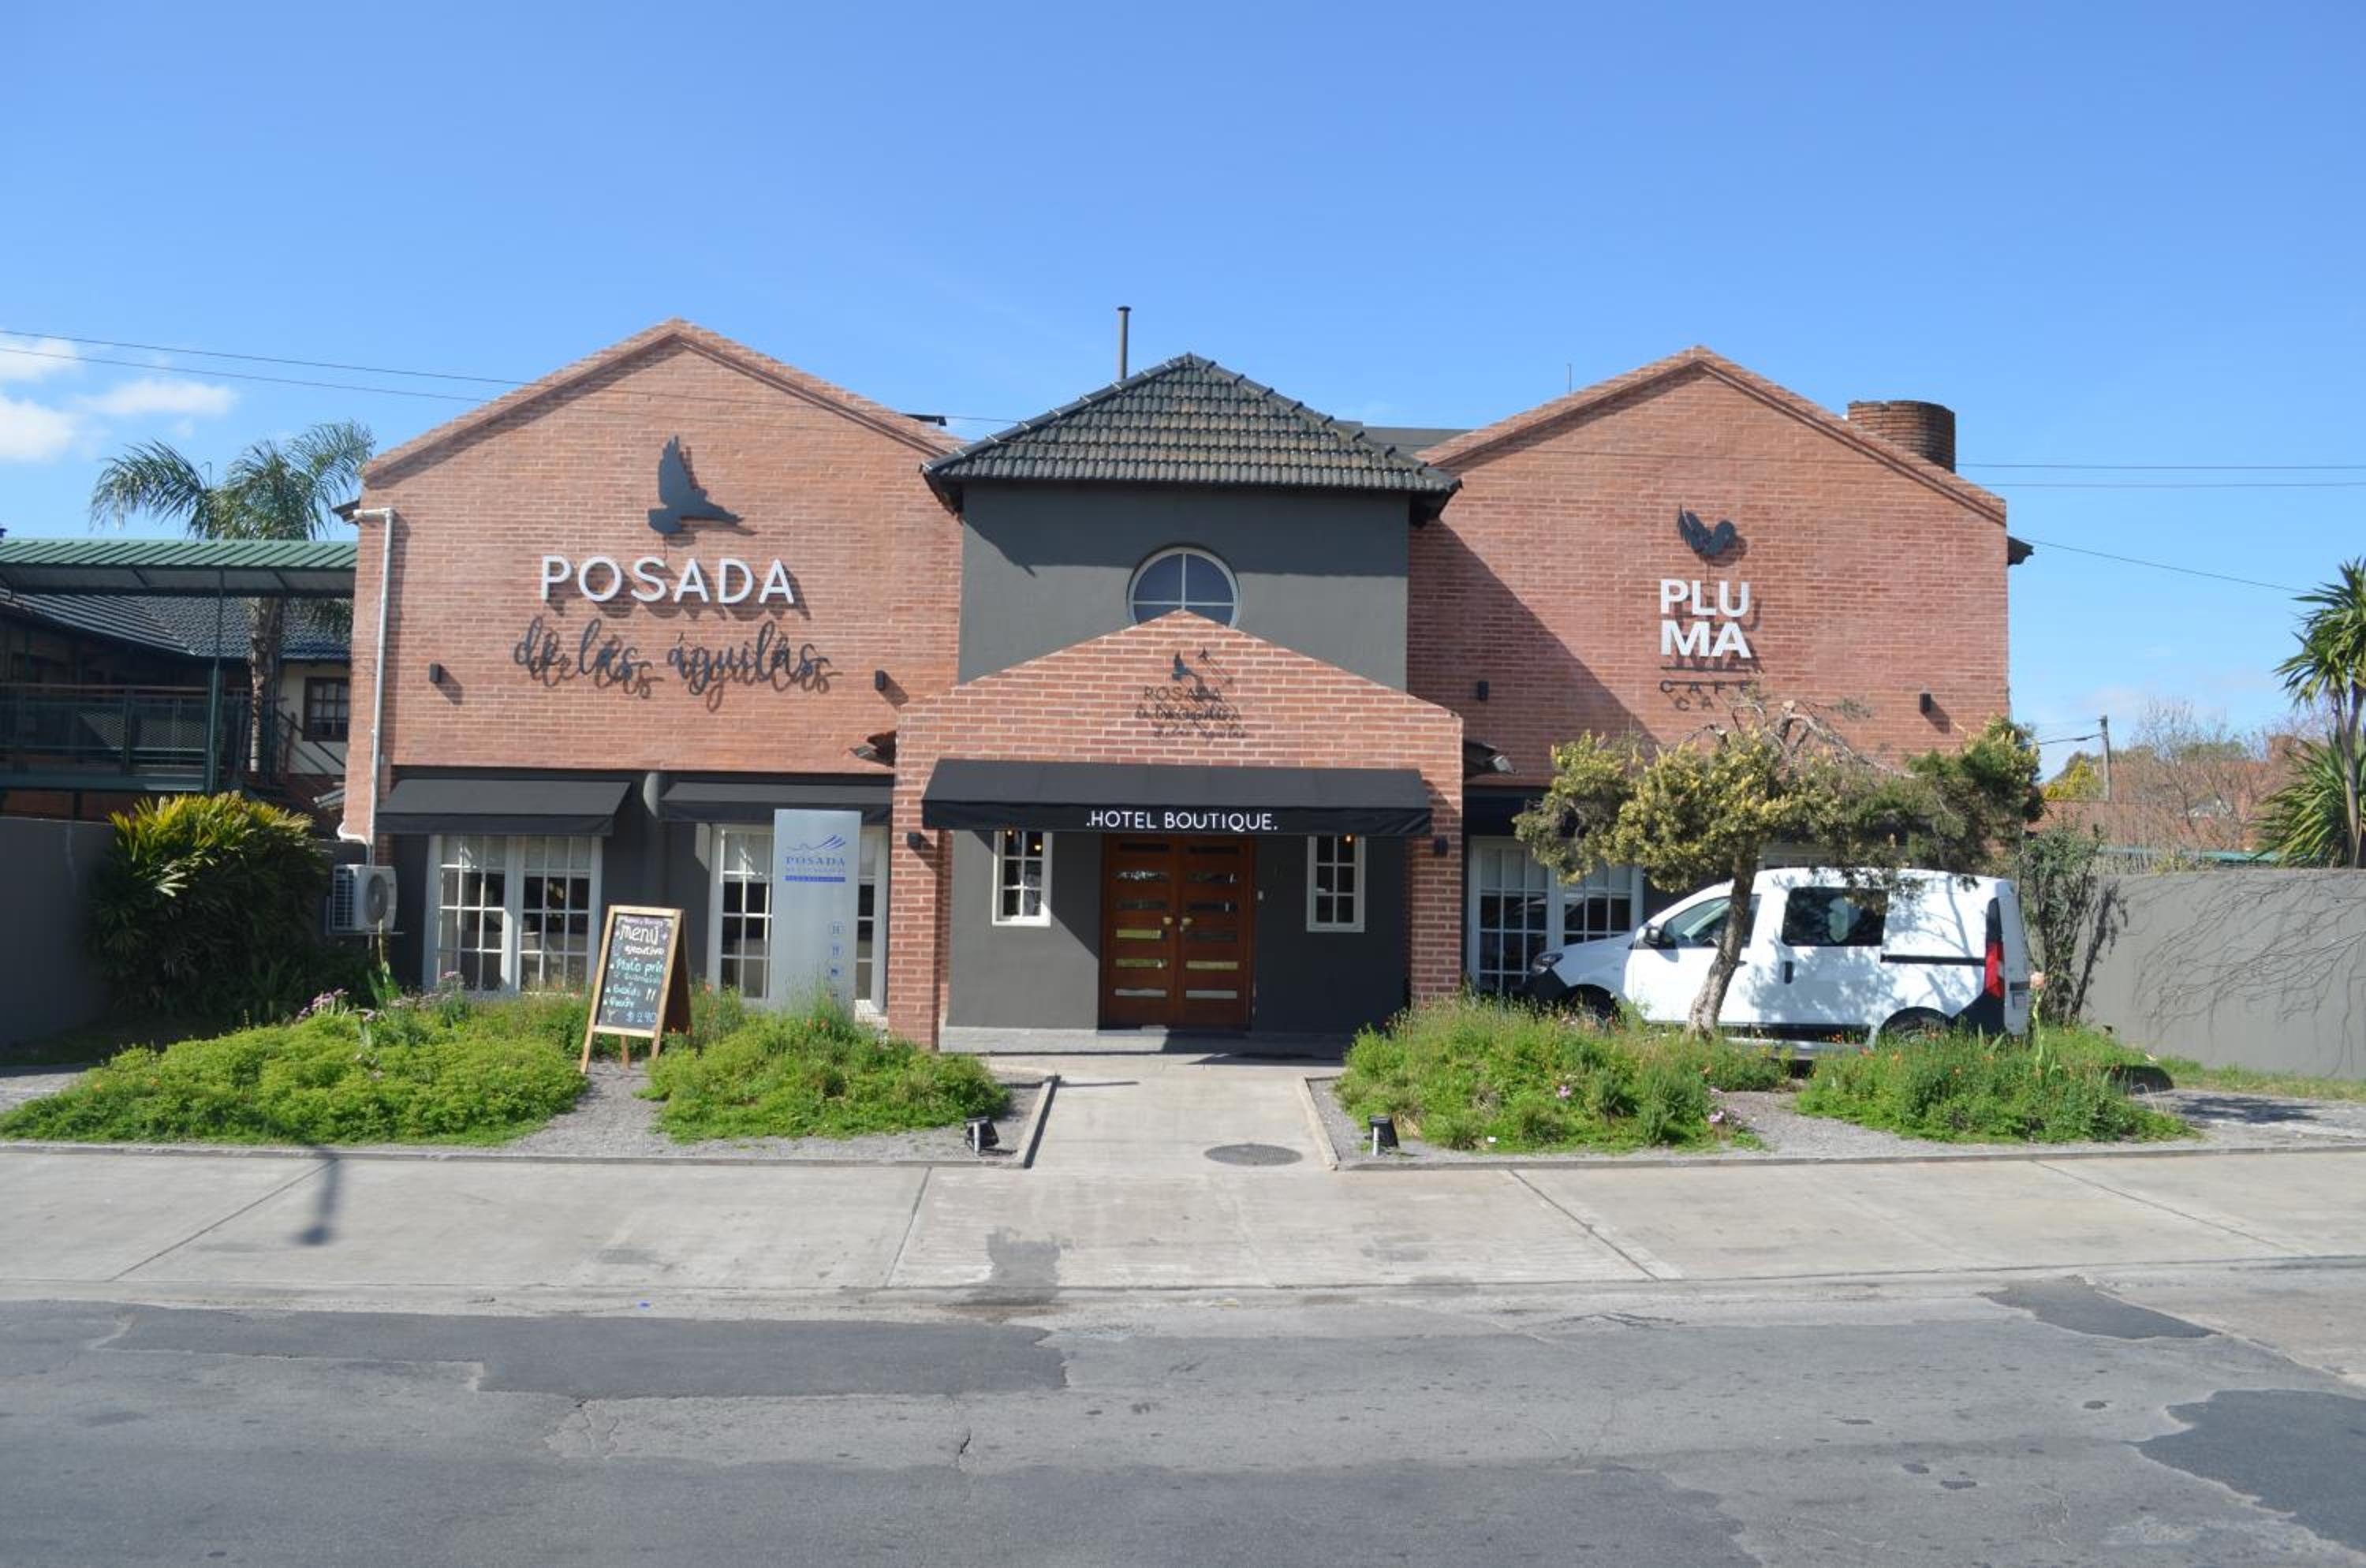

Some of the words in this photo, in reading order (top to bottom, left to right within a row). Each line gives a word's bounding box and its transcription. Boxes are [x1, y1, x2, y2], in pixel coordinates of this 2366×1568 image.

[540, 555, 794, 604] POSADA
[1660, 579, 1750, 618] PLU
[1660, 619, 1752, 659] MA
